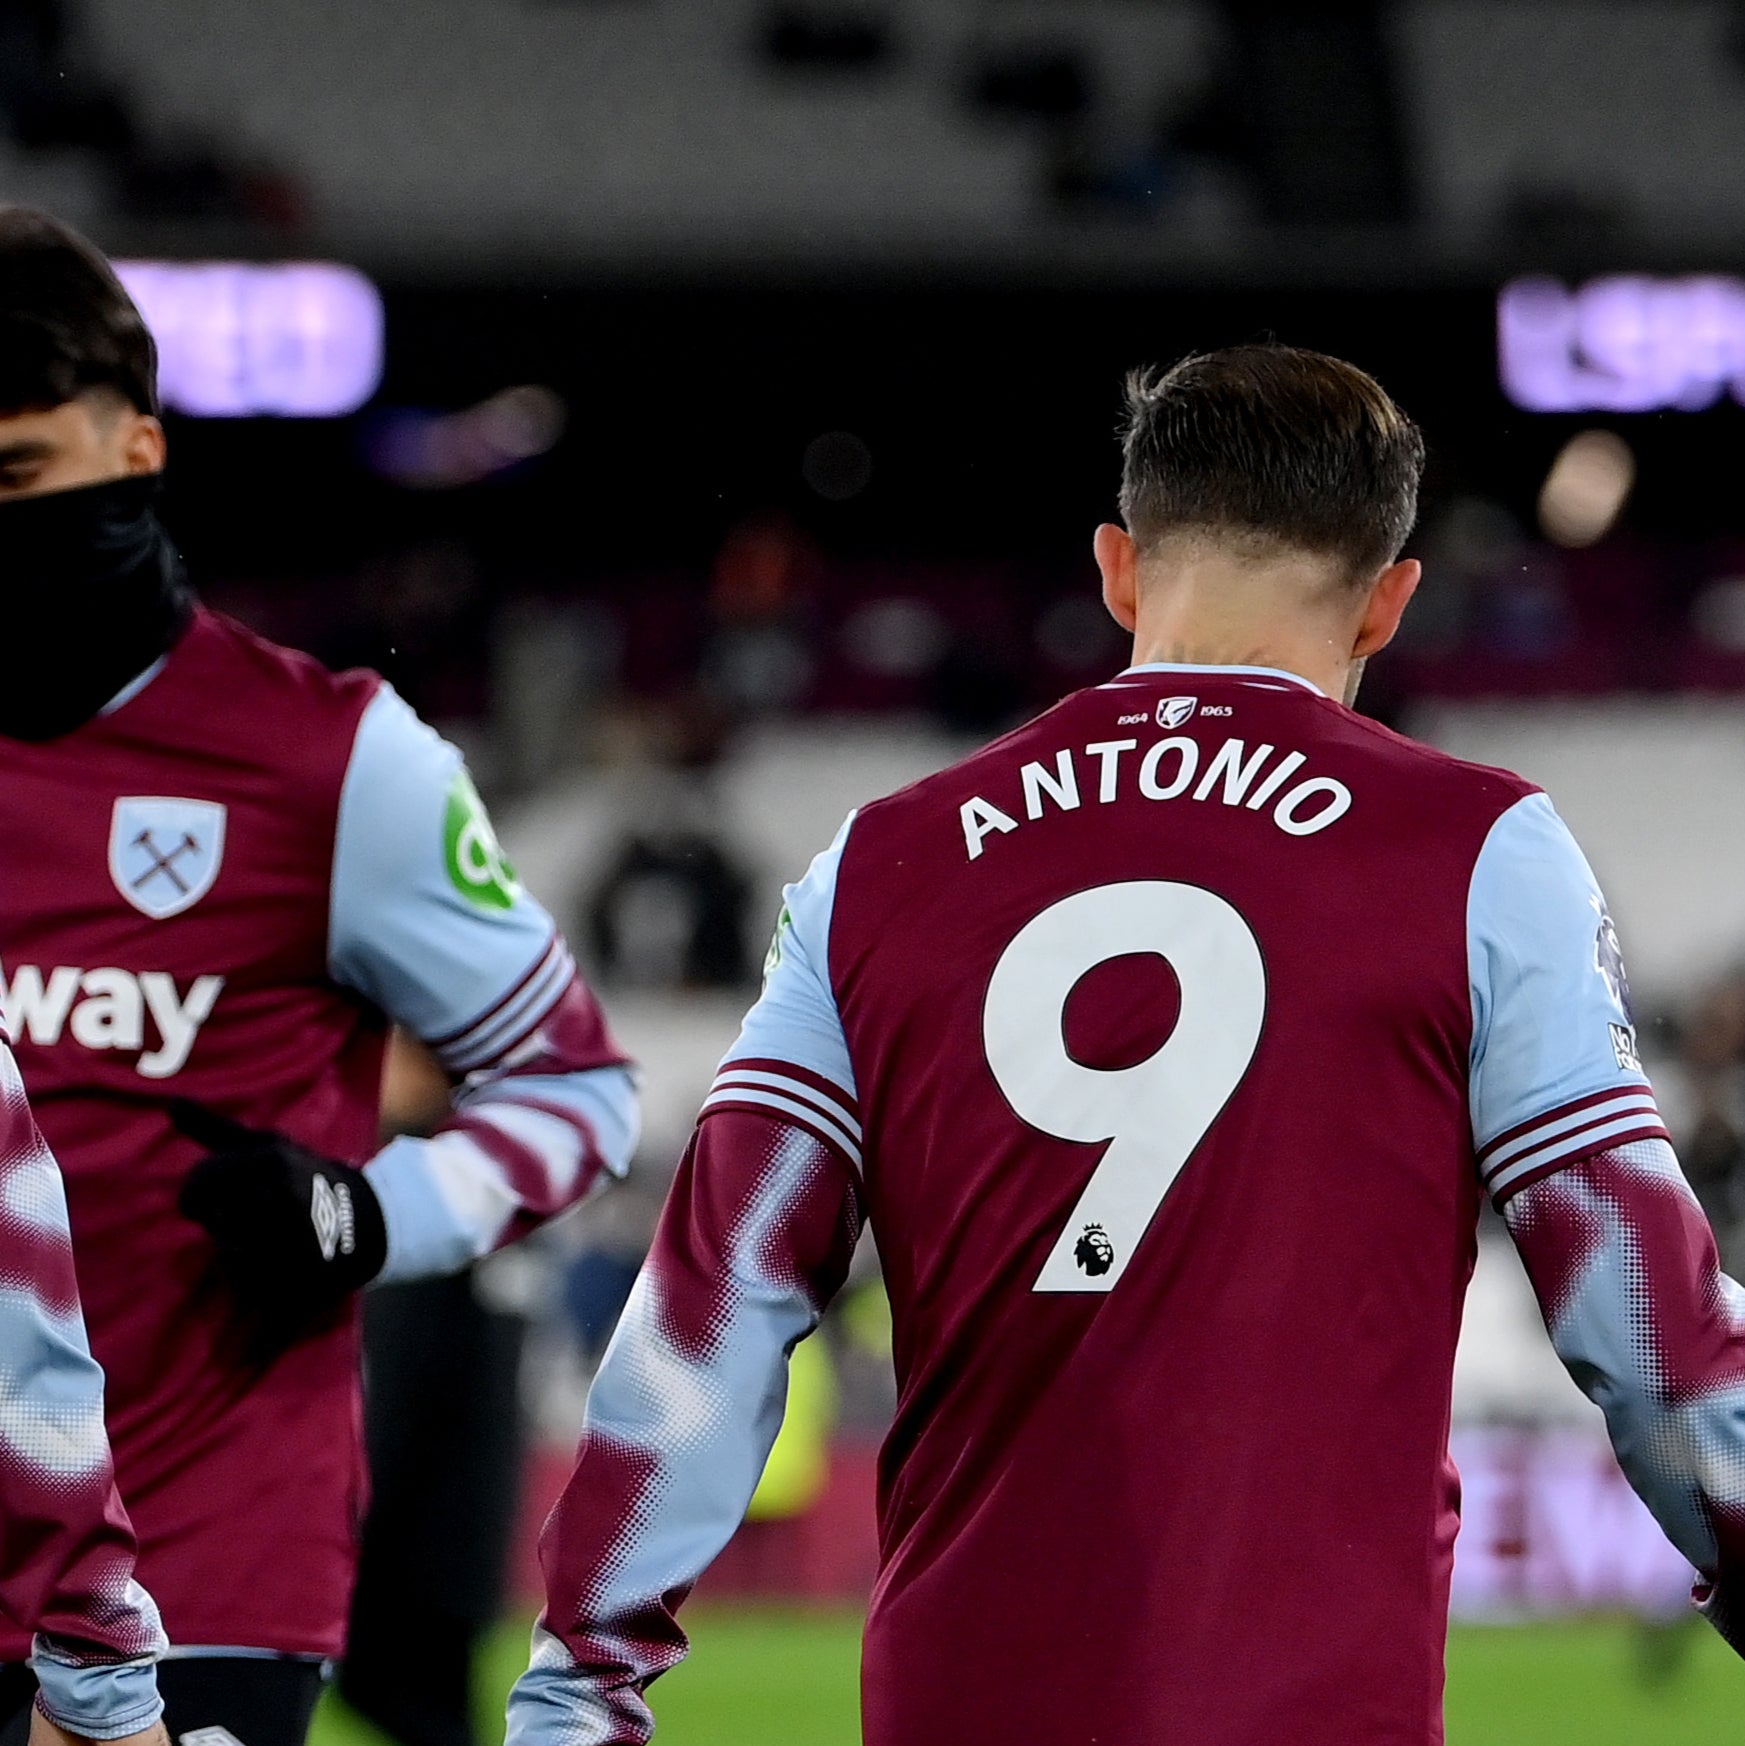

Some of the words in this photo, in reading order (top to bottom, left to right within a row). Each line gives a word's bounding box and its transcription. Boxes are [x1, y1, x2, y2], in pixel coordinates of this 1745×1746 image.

[1116, 712, 1149, 725] 1964
[1200, 705, 1234, 717] 1965
[958, 736, 1353, 861] ANTONIO
[981, 879, 1269, 1292] 9
